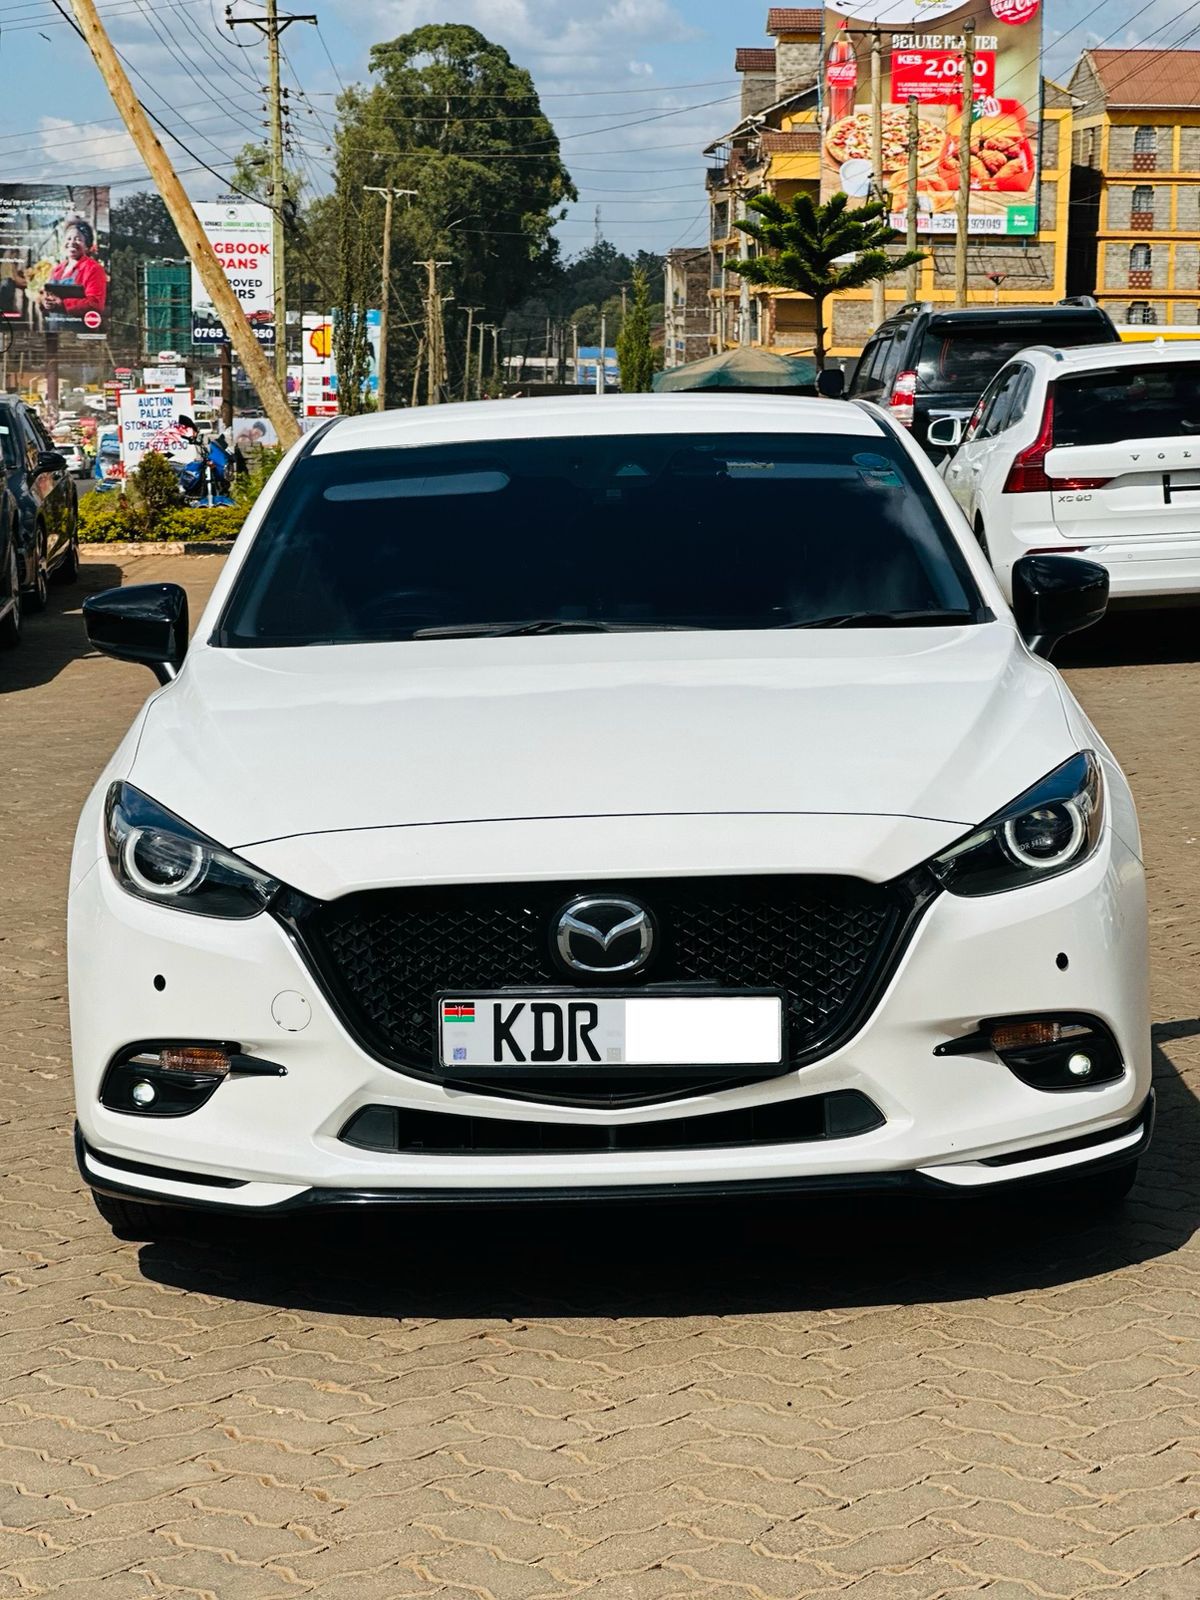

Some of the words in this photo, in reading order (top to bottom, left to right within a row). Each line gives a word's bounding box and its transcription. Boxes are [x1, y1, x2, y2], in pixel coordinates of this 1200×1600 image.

[892, 34, 942, 49] DELUXE
[944, 35, 998, 50] PLATER
[897, 54, 922, 64] KES
[903, 218, 929, 229] DER
[214, 243, 270, 255] GBOOK
[219, 258, 258, 269] OANS
[227, 279, 263, 287] ROVED
[194, 328, 223, 338] 0765
[138, 397, 173, 407] AUCTION
[141, 408, 172, 418] PALACE
[125, 420, 163, 430] STORAGE
[128, 442, 149, 451] 0764
[171, 441, 188, 450] 030
[493, 1002, 602, 1062] KDR
